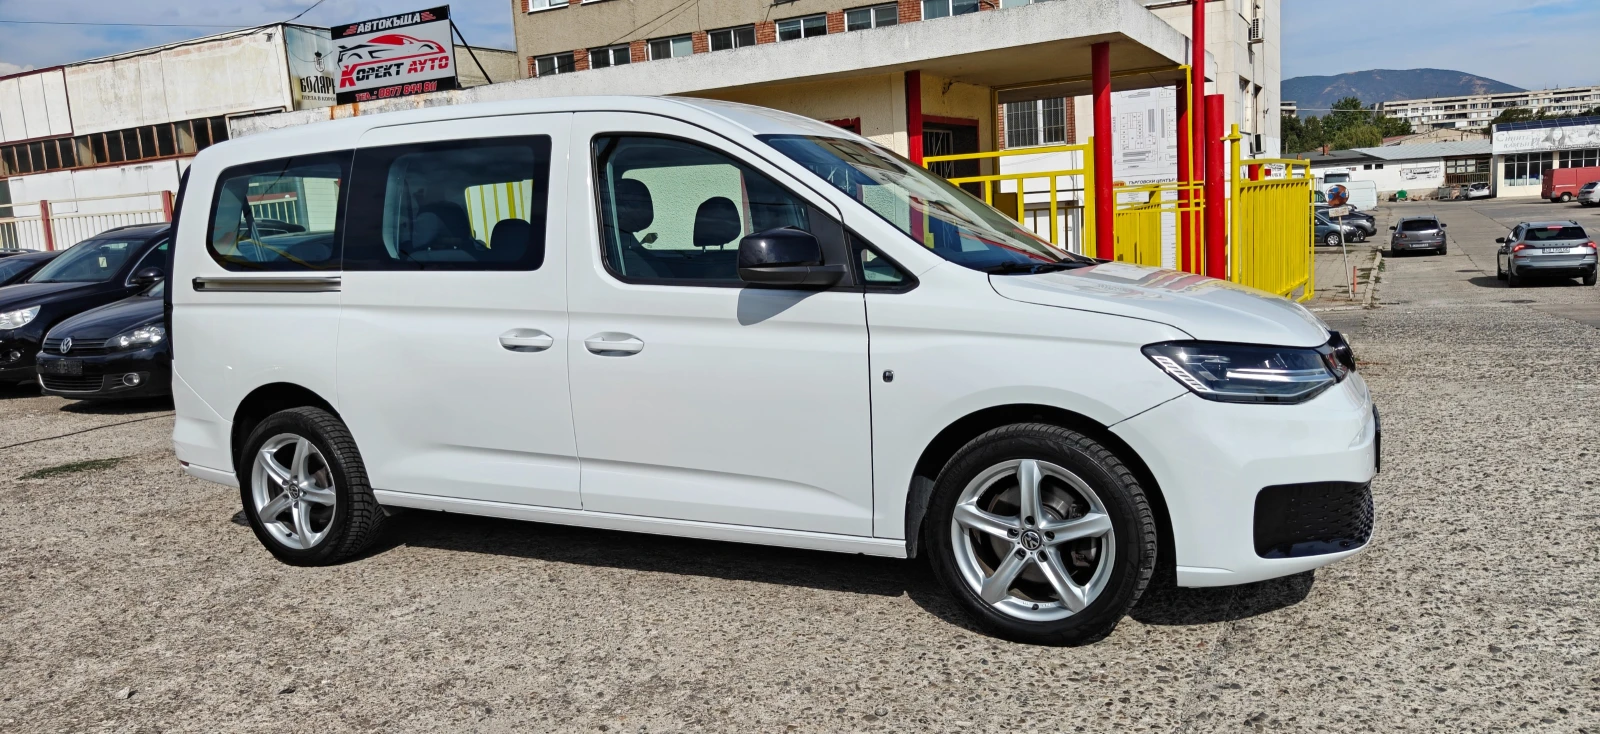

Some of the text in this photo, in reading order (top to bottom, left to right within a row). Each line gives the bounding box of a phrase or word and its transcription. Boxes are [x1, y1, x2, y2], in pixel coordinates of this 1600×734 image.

[340, 56, 450, 88] КОРЕКТ АУТО
[378, 86, 402, 99] 0877
[403, 82, 422, 95] 844
[424, 81, 438, 92] 811
